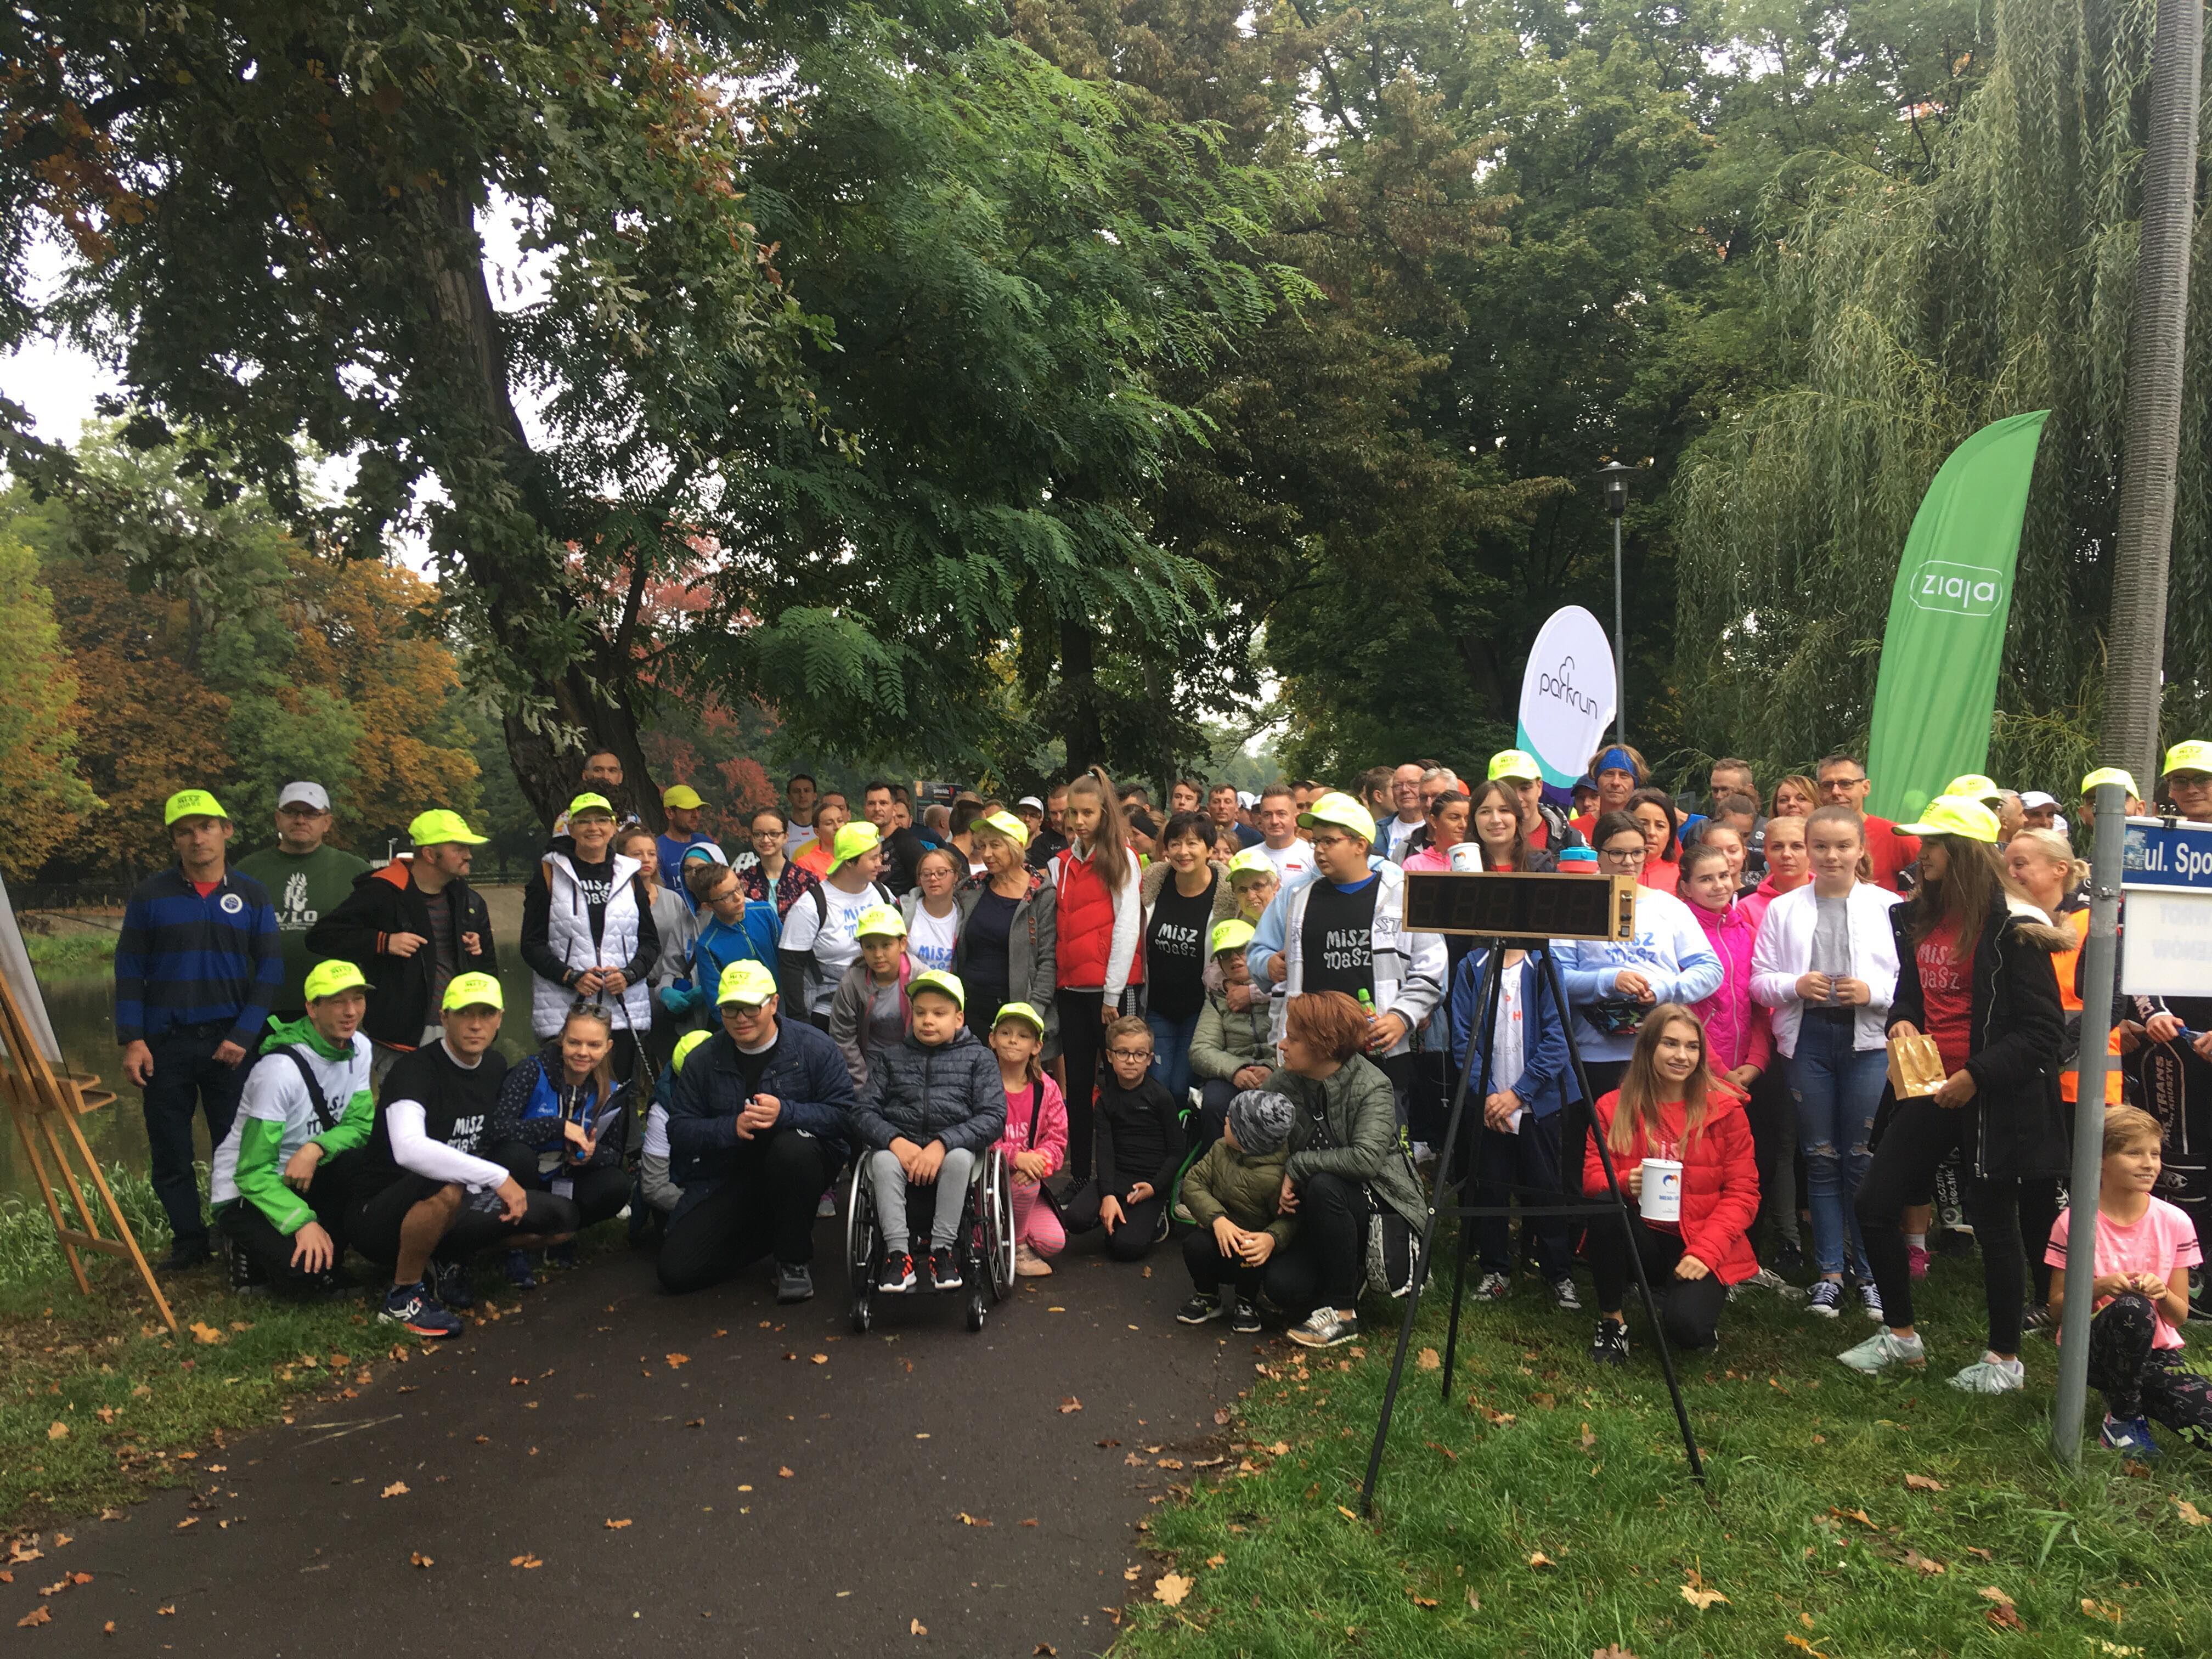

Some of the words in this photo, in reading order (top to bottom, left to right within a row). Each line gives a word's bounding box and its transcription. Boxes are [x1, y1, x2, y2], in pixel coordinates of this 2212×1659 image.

[1539, 656, 1598, 719] parkrun
[2145, 841, 2168, 872] ul.
[2175, 843, 2212, 881] Spo
[2155, 1055, 2169, 1114] TRANS
[1945, 1168, 1959, 1205] electric
